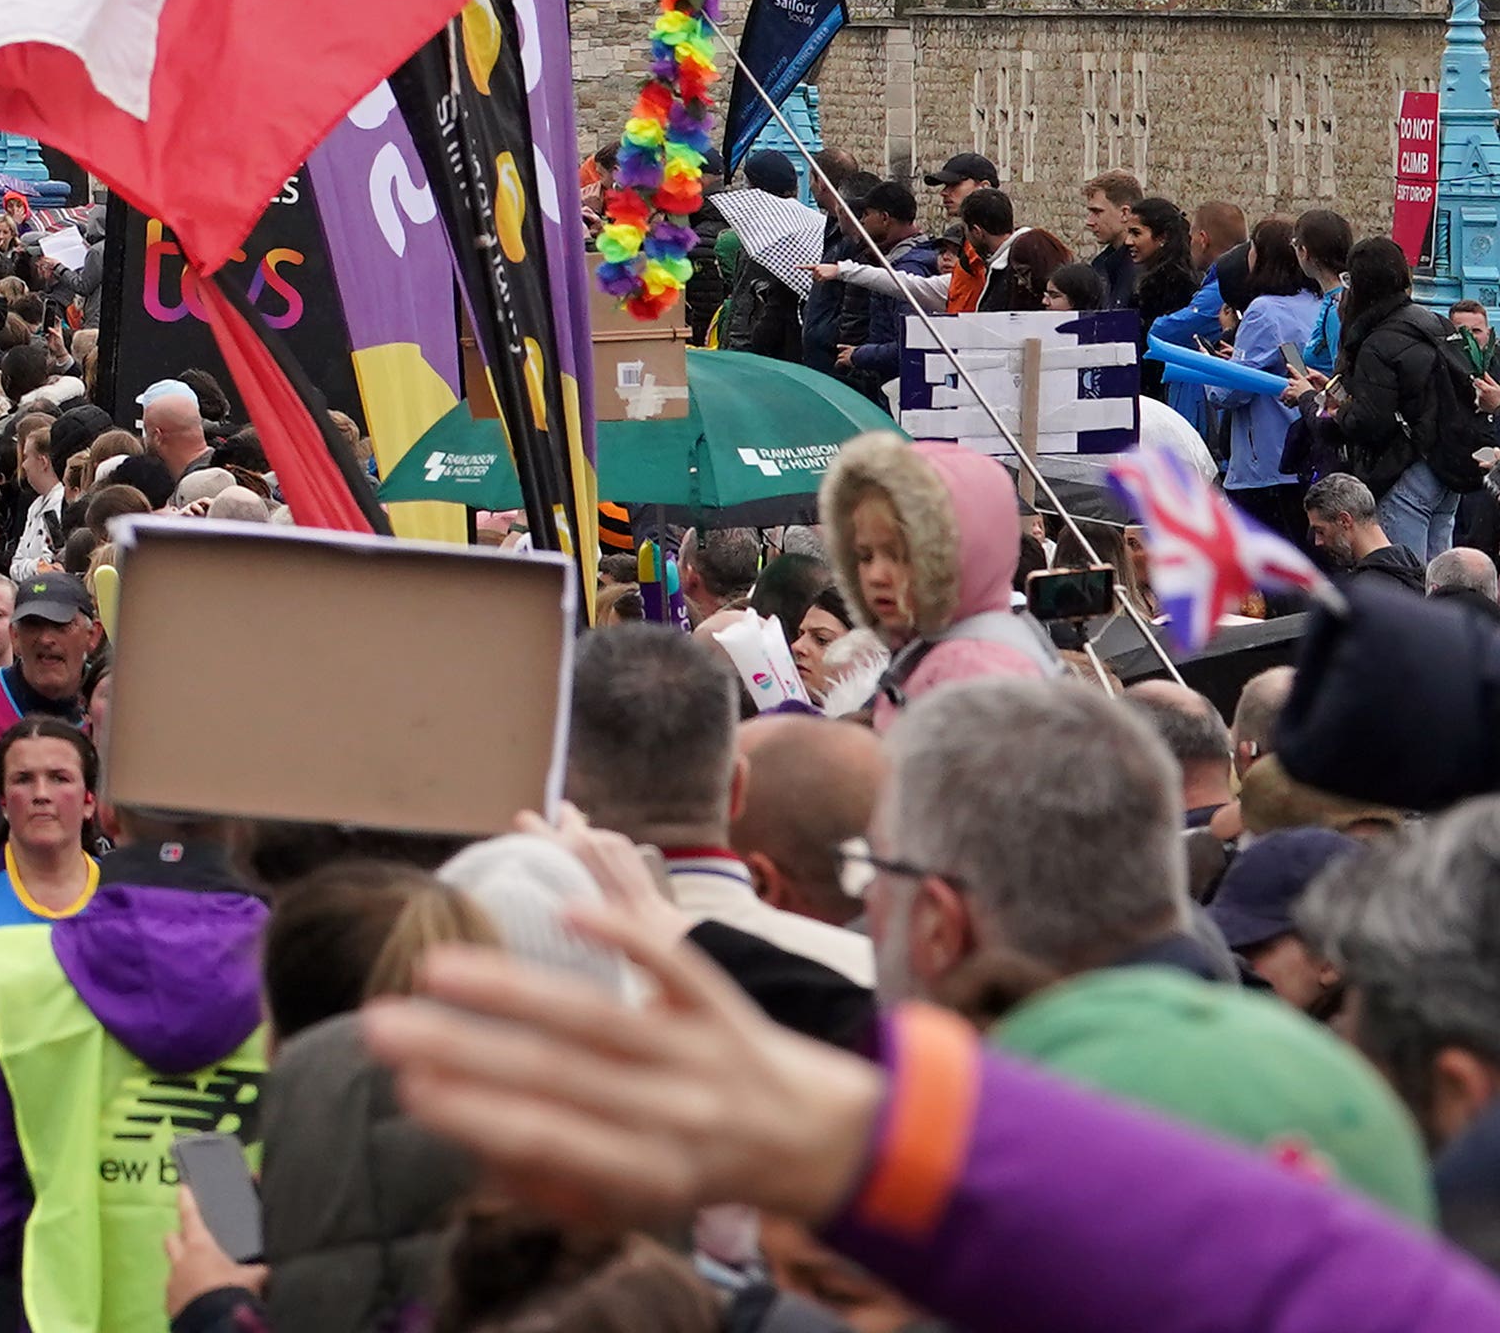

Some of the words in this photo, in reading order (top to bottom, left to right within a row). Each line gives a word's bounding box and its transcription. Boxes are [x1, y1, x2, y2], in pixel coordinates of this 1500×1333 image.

[1400, 118, 1412, 140] DO
[1412, 118, 1435, 141] NOT
[1401, 151, 1429, 174] CLIMB
[1411, 185, 1433, 203] DROP
[758, 443, 840, 460] RAWLINSON
[100, 1157, 148, 1183] ew
